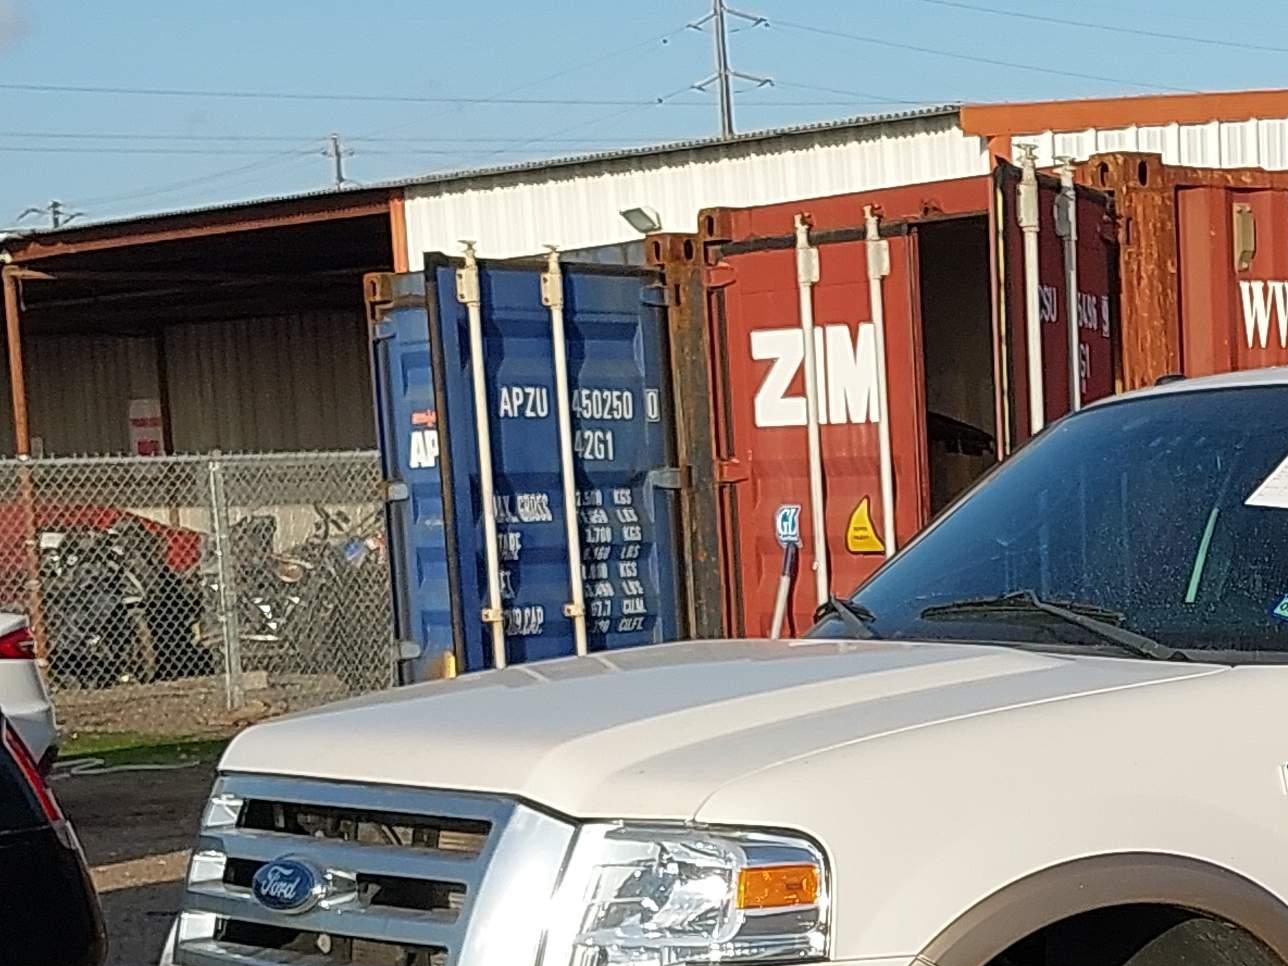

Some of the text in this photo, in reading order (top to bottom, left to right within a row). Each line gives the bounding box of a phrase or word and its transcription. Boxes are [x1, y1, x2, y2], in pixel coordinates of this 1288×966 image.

[750, 322, 880, 428] ZIM
[500, 387, 548, 417] APZU
[572, 389, 633, 419] 450250
[574, 430, 614, 461] 42G1
[260, 865, 301, 900] Ford
